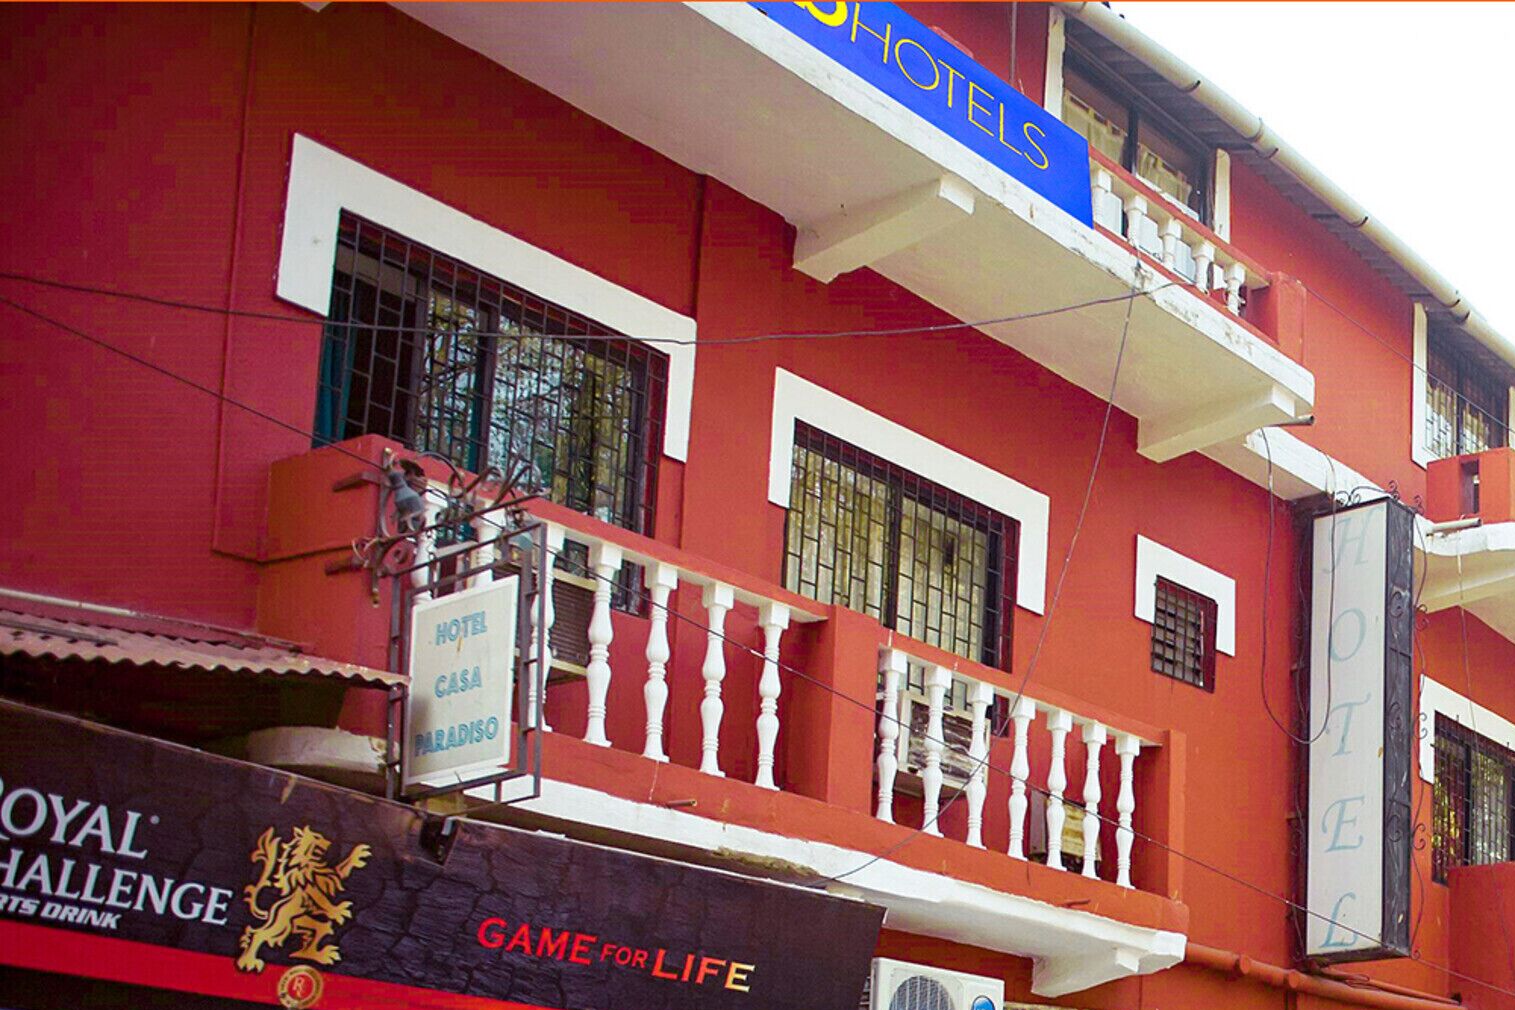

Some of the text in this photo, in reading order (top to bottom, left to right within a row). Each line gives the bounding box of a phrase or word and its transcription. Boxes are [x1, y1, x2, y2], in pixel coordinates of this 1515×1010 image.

[850, 2, 1049, 170] HOTELS
[436, 611, 488, 646] HOTEL
[434, 666, 482, 699] CASA
[414, 716, 500, 757] PARADISO
[1319, 506, 1385, 950] HOTEL
[0, 776, 148, 860] OYAL
[40, 901, 122, 930] DRINK
[477, 917, 755, 993] GAME FOR LIFE
